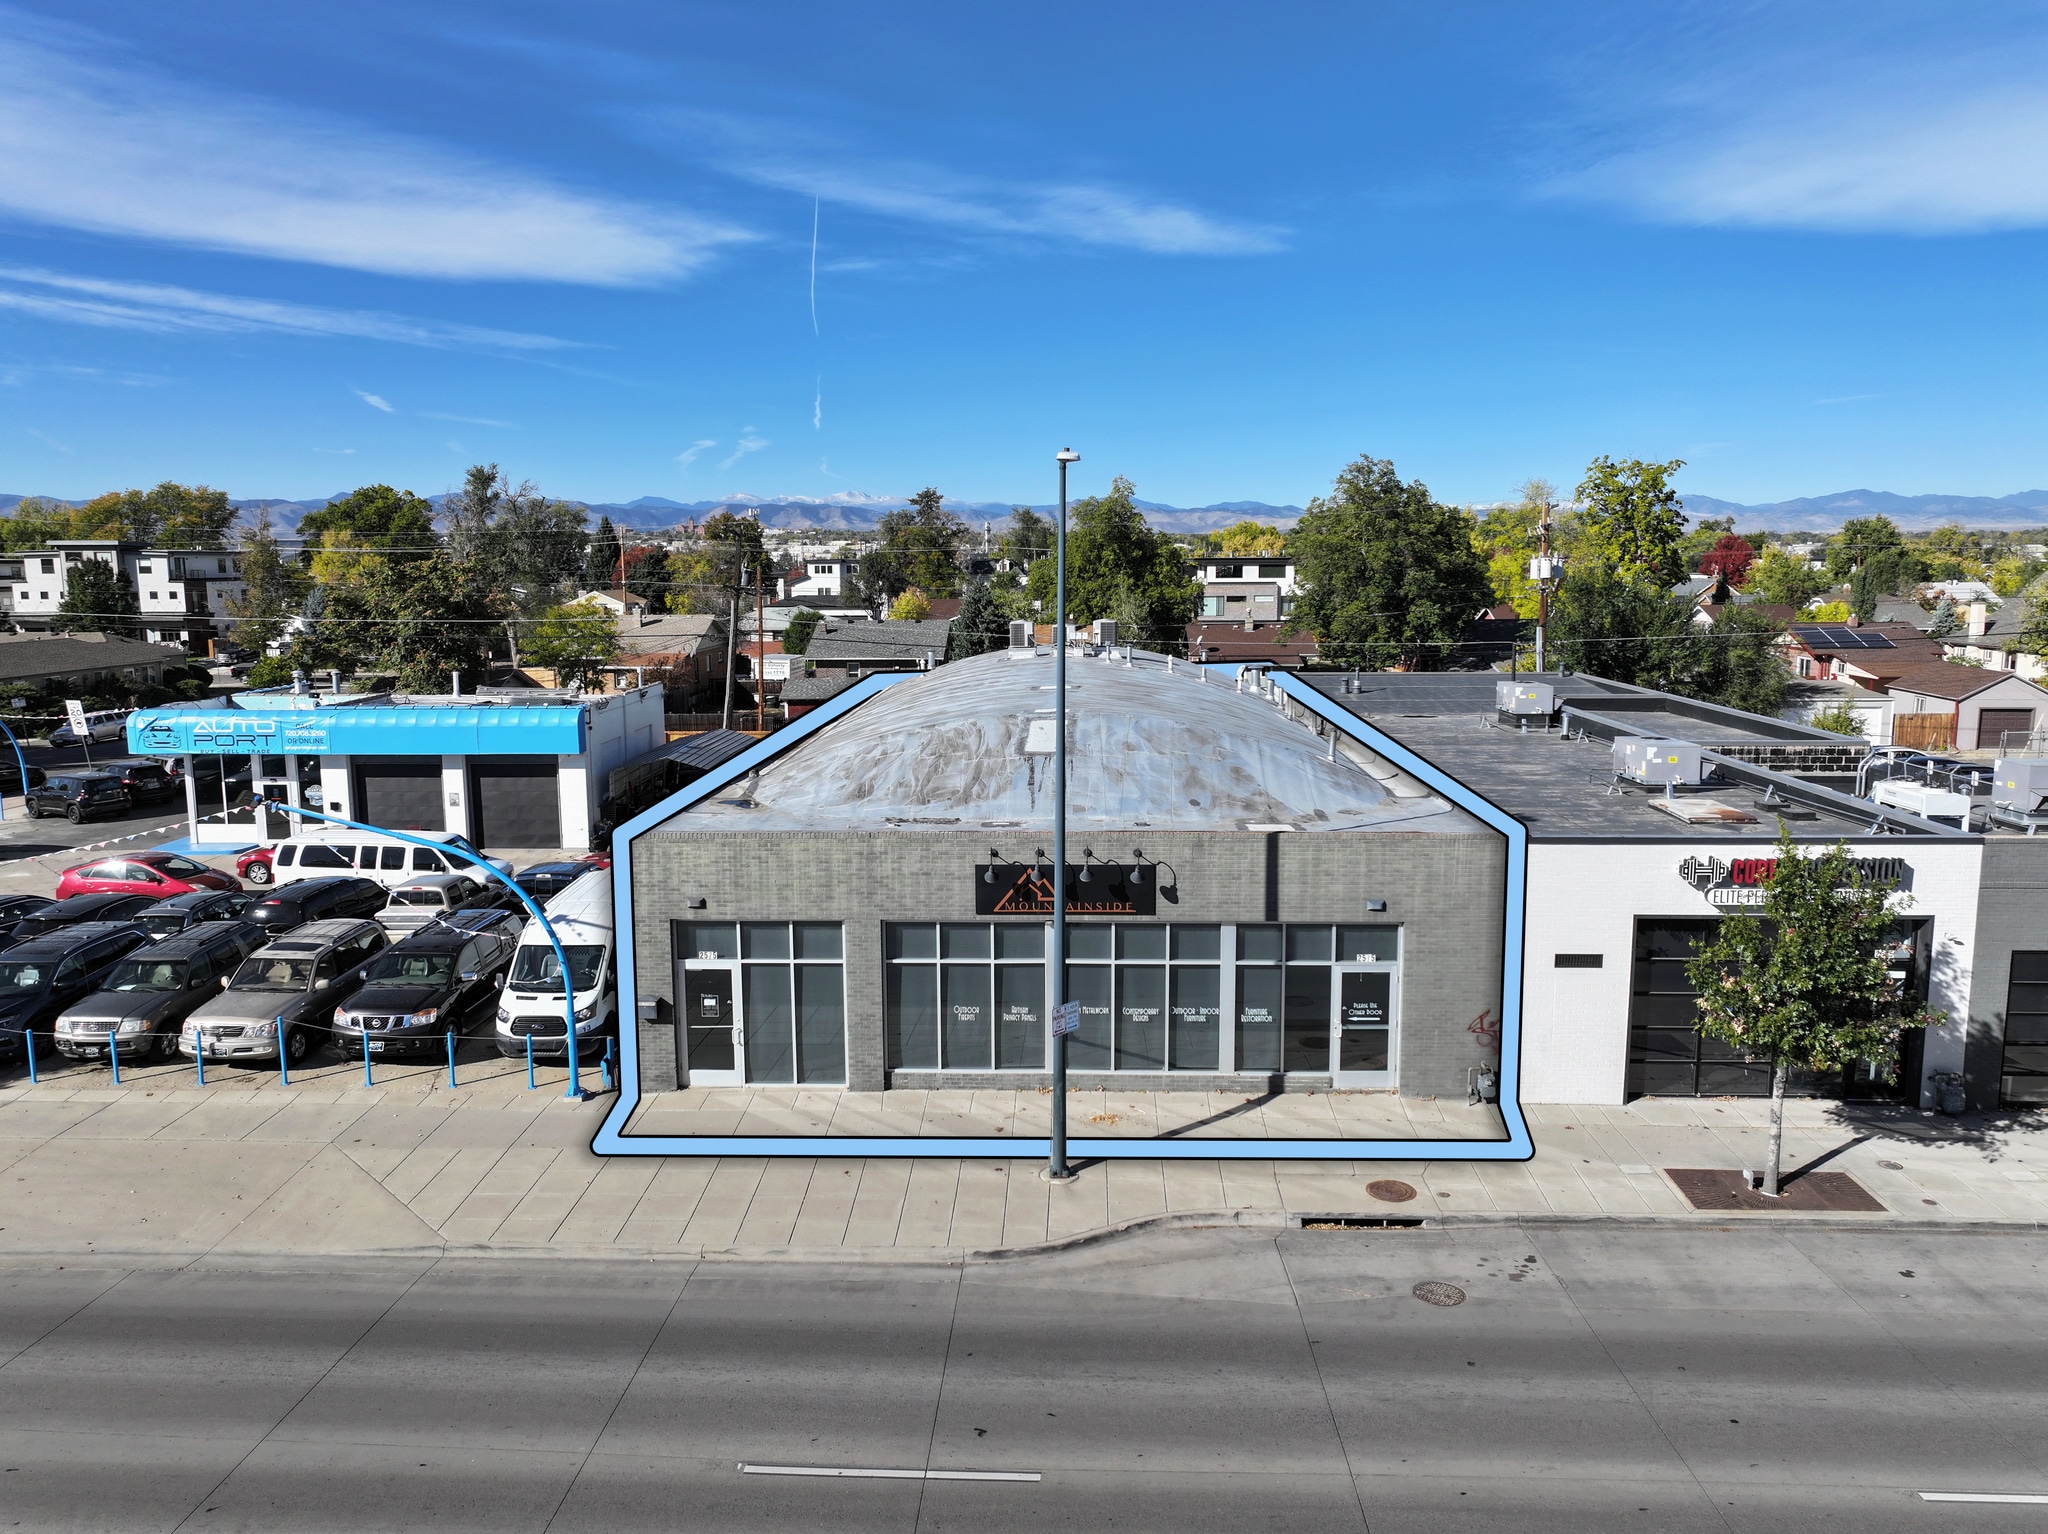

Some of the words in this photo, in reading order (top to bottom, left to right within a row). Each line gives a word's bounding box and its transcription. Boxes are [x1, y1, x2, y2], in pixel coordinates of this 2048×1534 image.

[70, 709, 82, 717] 20
[193, 720, 275, 733] AUTO
[193, 734, 277, 747] PORT
[1713, 889, 1743, 904] ELITE
[1004, 901, 1133, 911] MOUNAINSIDE
[699, 951, 718, 959] 2575
[953, 1005, 980, 1014] OUTDOOR
[1011, 1005, 1029, 1014] ARTISAN
[1082, 1006, 1110, 1015] METALWORK
[1122, 1007, 1160, 1015] CONTEMPORARY
[1171, 1006, 1196, 1015] OUTDOOR
[1200, 1006, 1220, 1015] INDOOR
[1245, 1007, 1268, 1015] FURNITURE
[1003, 1013, 1020, 1021] PRIVACY
[1021, 1013, 1037, 1022] PANELS
[1132, 1014, 1150, 1022] DESIGNS
[1241, 1014, 1273, 1022] RESTORATION
